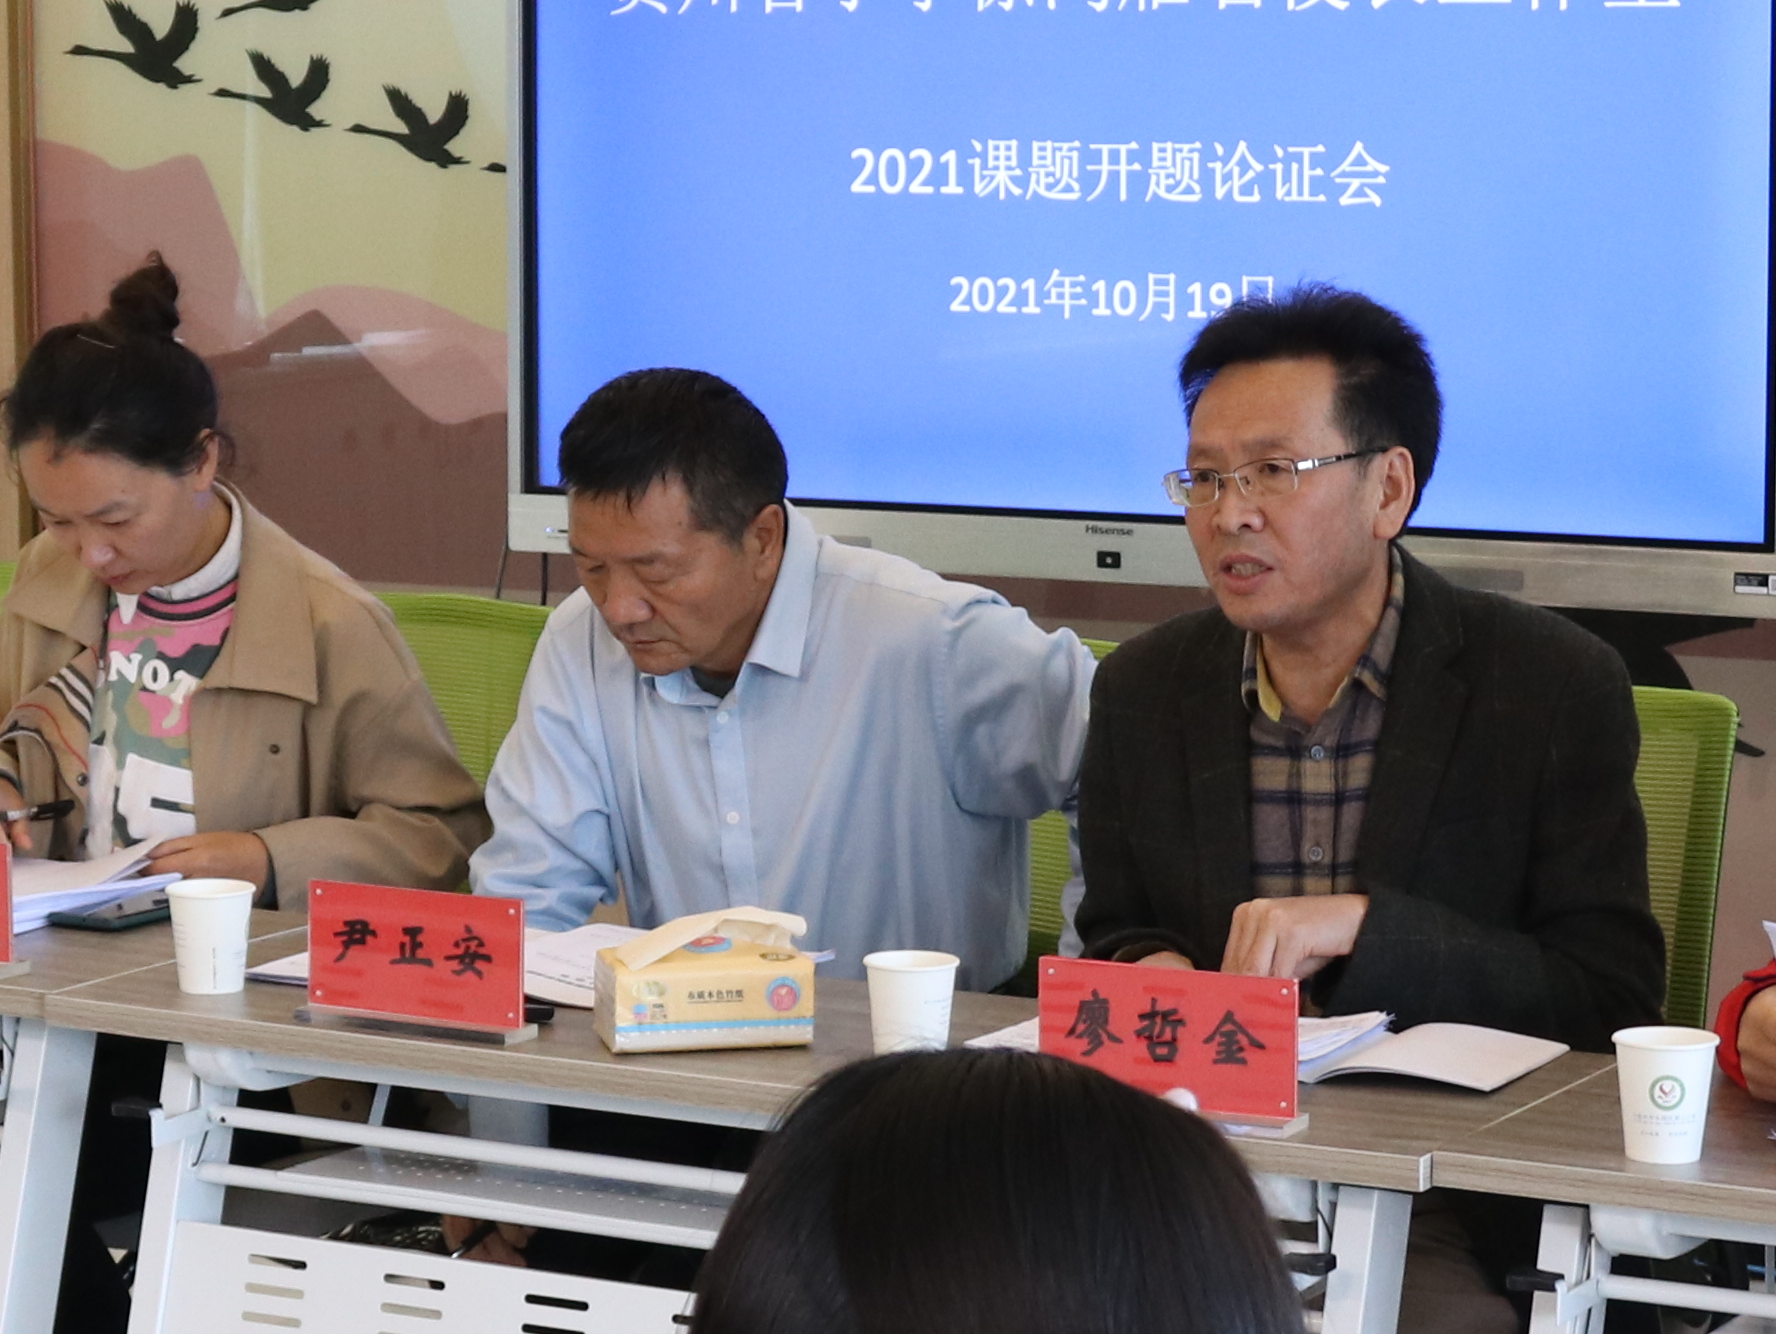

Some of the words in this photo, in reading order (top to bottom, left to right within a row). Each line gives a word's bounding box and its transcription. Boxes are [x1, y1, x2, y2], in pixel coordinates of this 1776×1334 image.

[849, 138, 1392, 208] 2021课题开题论证会
[1084, 524, 1135, 537] Hisense
[332, 918, 494, 980] 尹正安
[1065, 988, 1267, 1065] 廖哲金
